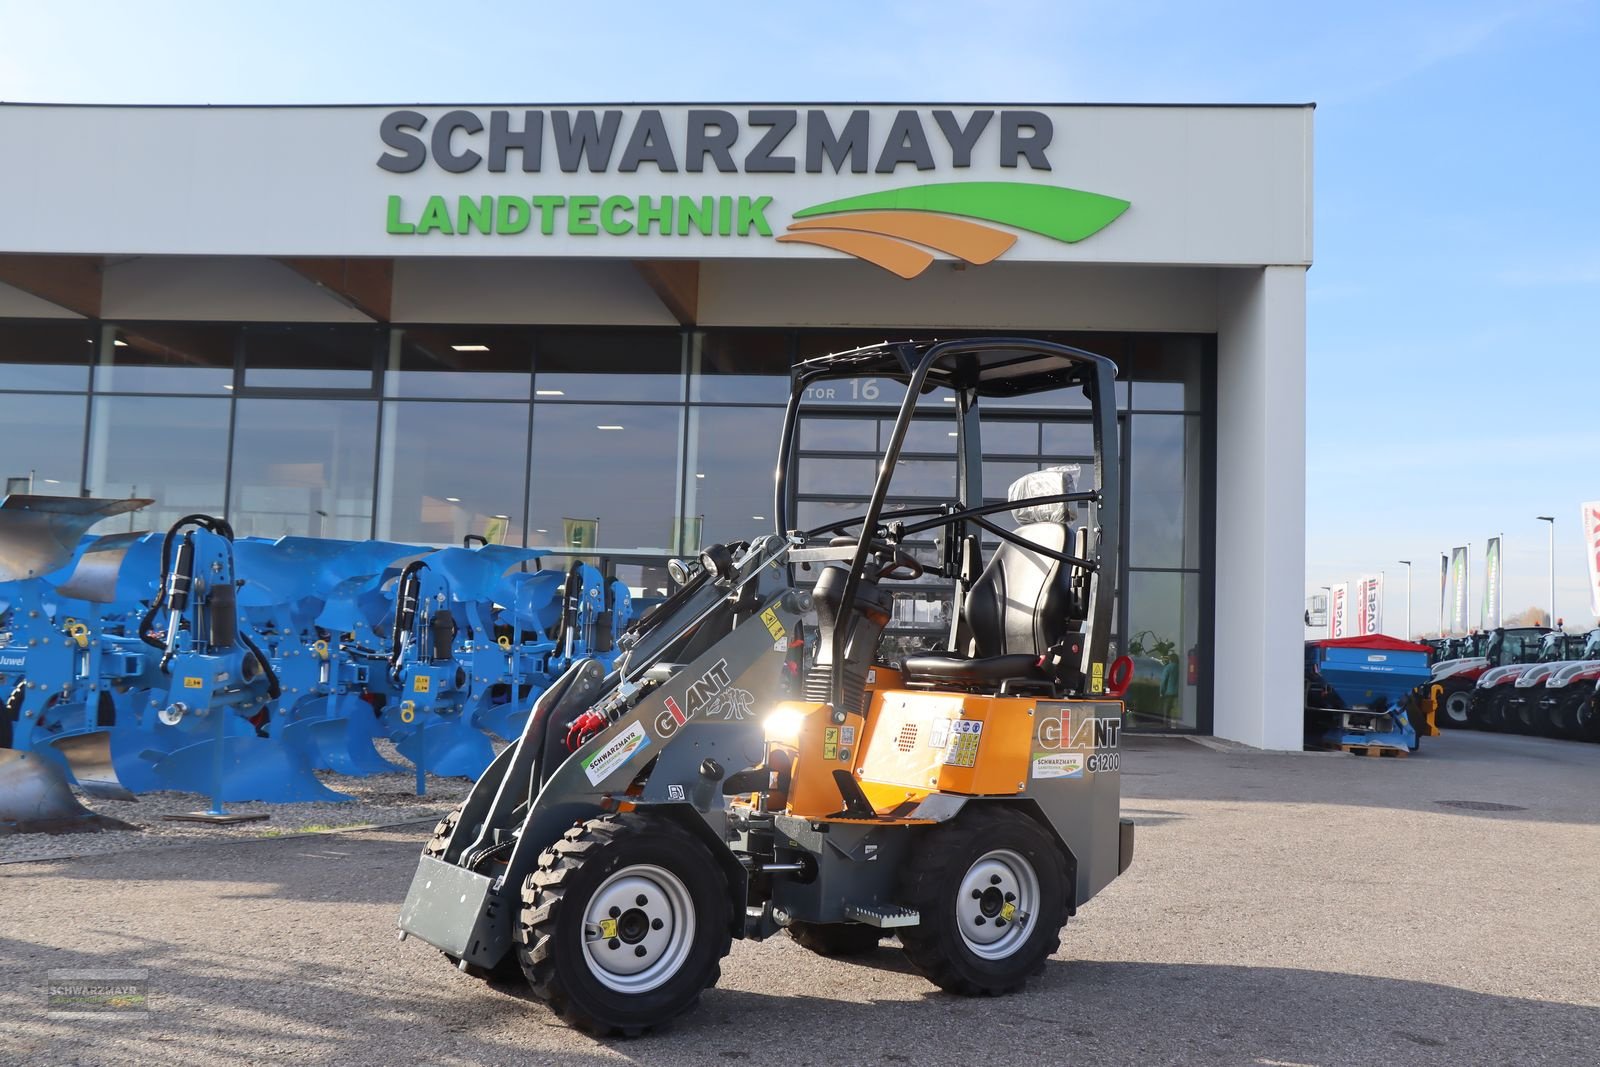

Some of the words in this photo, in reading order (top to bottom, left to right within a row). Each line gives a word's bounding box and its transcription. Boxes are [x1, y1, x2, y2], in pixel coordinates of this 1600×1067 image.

[376, 109, 1054, 174] SCHWARZMAYR
[386, 195, 773, 236] LANDTECHNIK
[806, 387, 835, 399] TOR
[849, 378, 880, 400] 16
[0, 656, 25, 666] Juwel
[590, 732, 636, 769] SCHWARZMAYR
[1087, 753, 1120, 773] G1200
